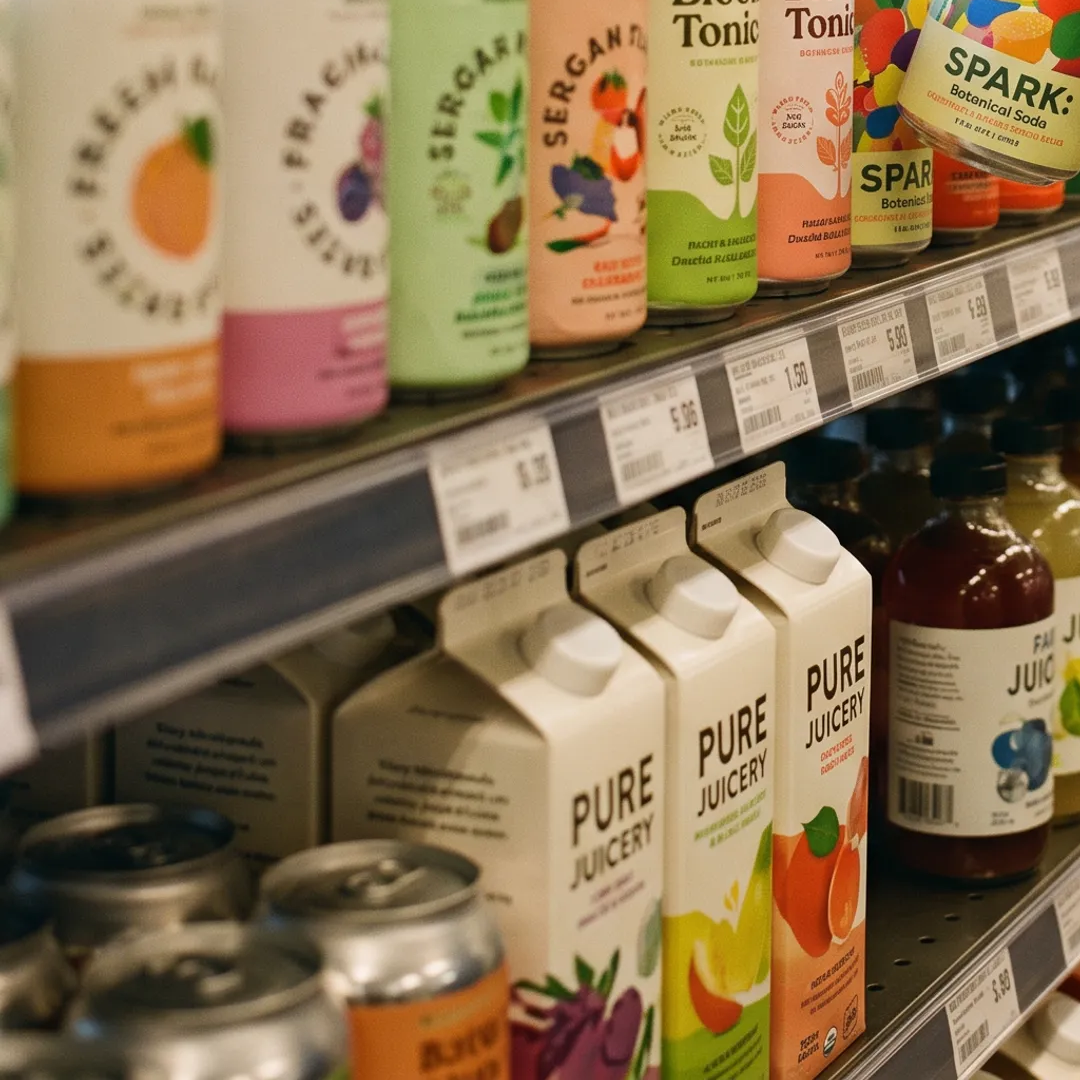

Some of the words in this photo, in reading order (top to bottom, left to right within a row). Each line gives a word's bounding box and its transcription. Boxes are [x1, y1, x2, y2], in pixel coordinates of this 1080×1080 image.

[672, 10, 760, 48] Tonic
[860, 159, 932, 192] SPAR
[885, 322, 908, 352] 5.90
[784, 360, 809, 392] 1.50
[807, 634, 865, 713] PURE
[1007, 653, 1055, 696] JUIC
[698, 693, 767, 779] PURE
[805, 686, 865, 749] JUICERY
[572, 752, 654, 848] PURE
[697, 748, 768, 817] JUICERY
[569, 811, 655, 892] JUICERY
